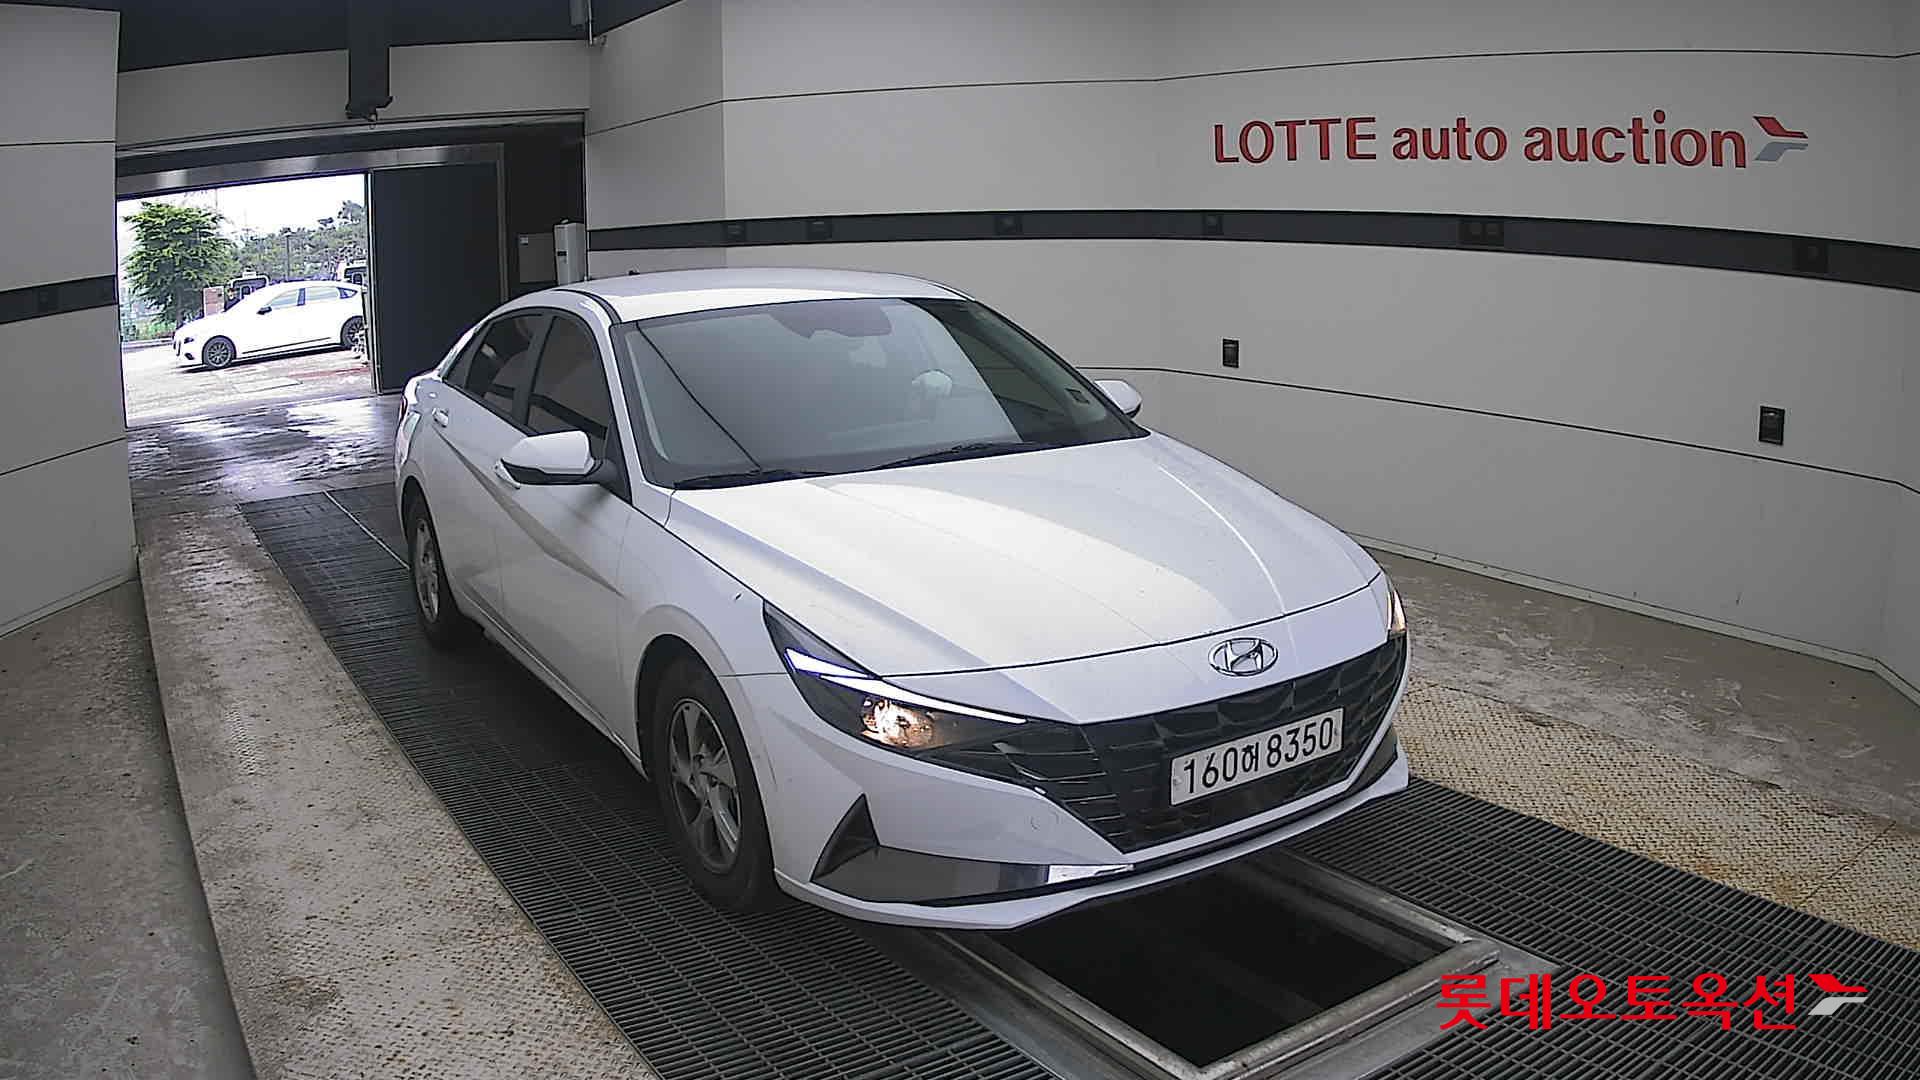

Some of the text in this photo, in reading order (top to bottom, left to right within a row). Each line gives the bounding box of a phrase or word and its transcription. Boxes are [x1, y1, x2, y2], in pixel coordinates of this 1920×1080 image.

[1214, 109, 1746, 168] LOTTE auto auction
[1183, 717, 1334, 794] 160허 8350
